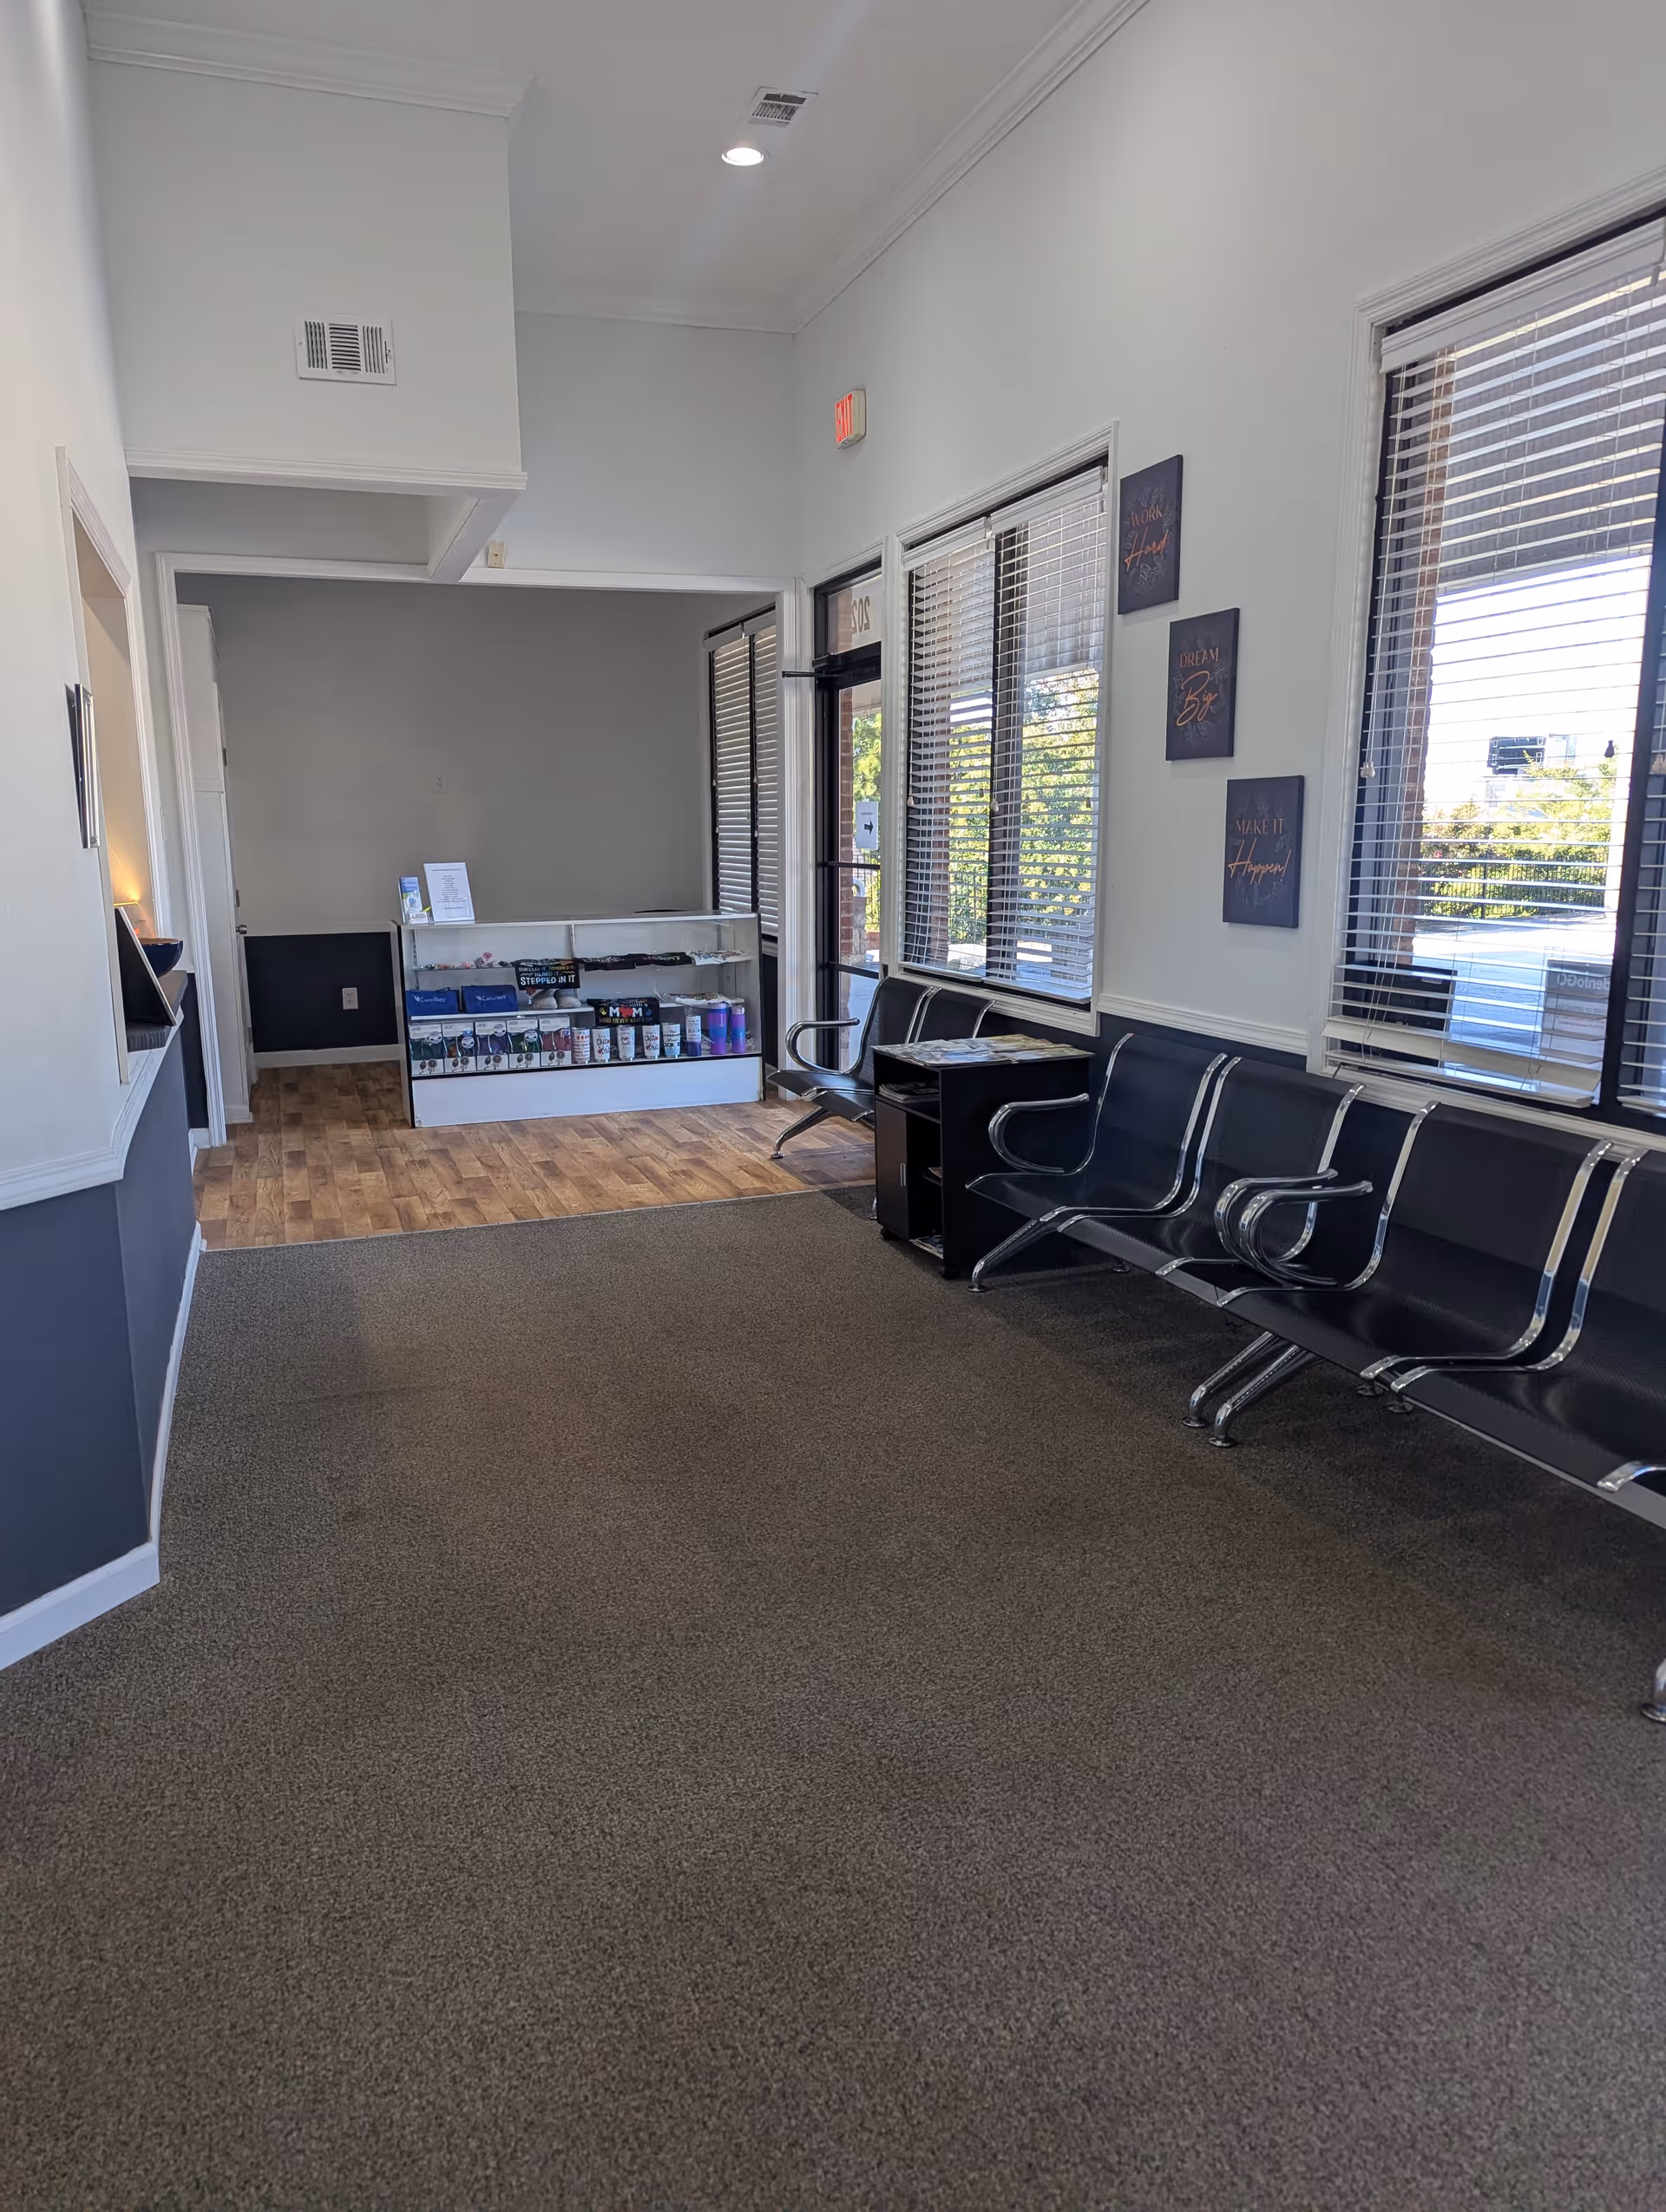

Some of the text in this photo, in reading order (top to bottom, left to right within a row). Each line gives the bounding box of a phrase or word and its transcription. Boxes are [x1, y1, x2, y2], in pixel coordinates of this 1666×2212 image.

[835, 393, 853, 443] EXIT
[1131, 505, 1163, 528] WORK
[1125, 526, 1169, 573] Hard
[1179, 647, 1219, 669] DREAM
[1176, 670, 1218, 727] Big
[1236, 818, 1285, 834] MAKE IT
[1227, 836, 1292, 886] Happen!
[520, 976, 557, 986] STEPPED
[568, 974, 576, 983] IT
